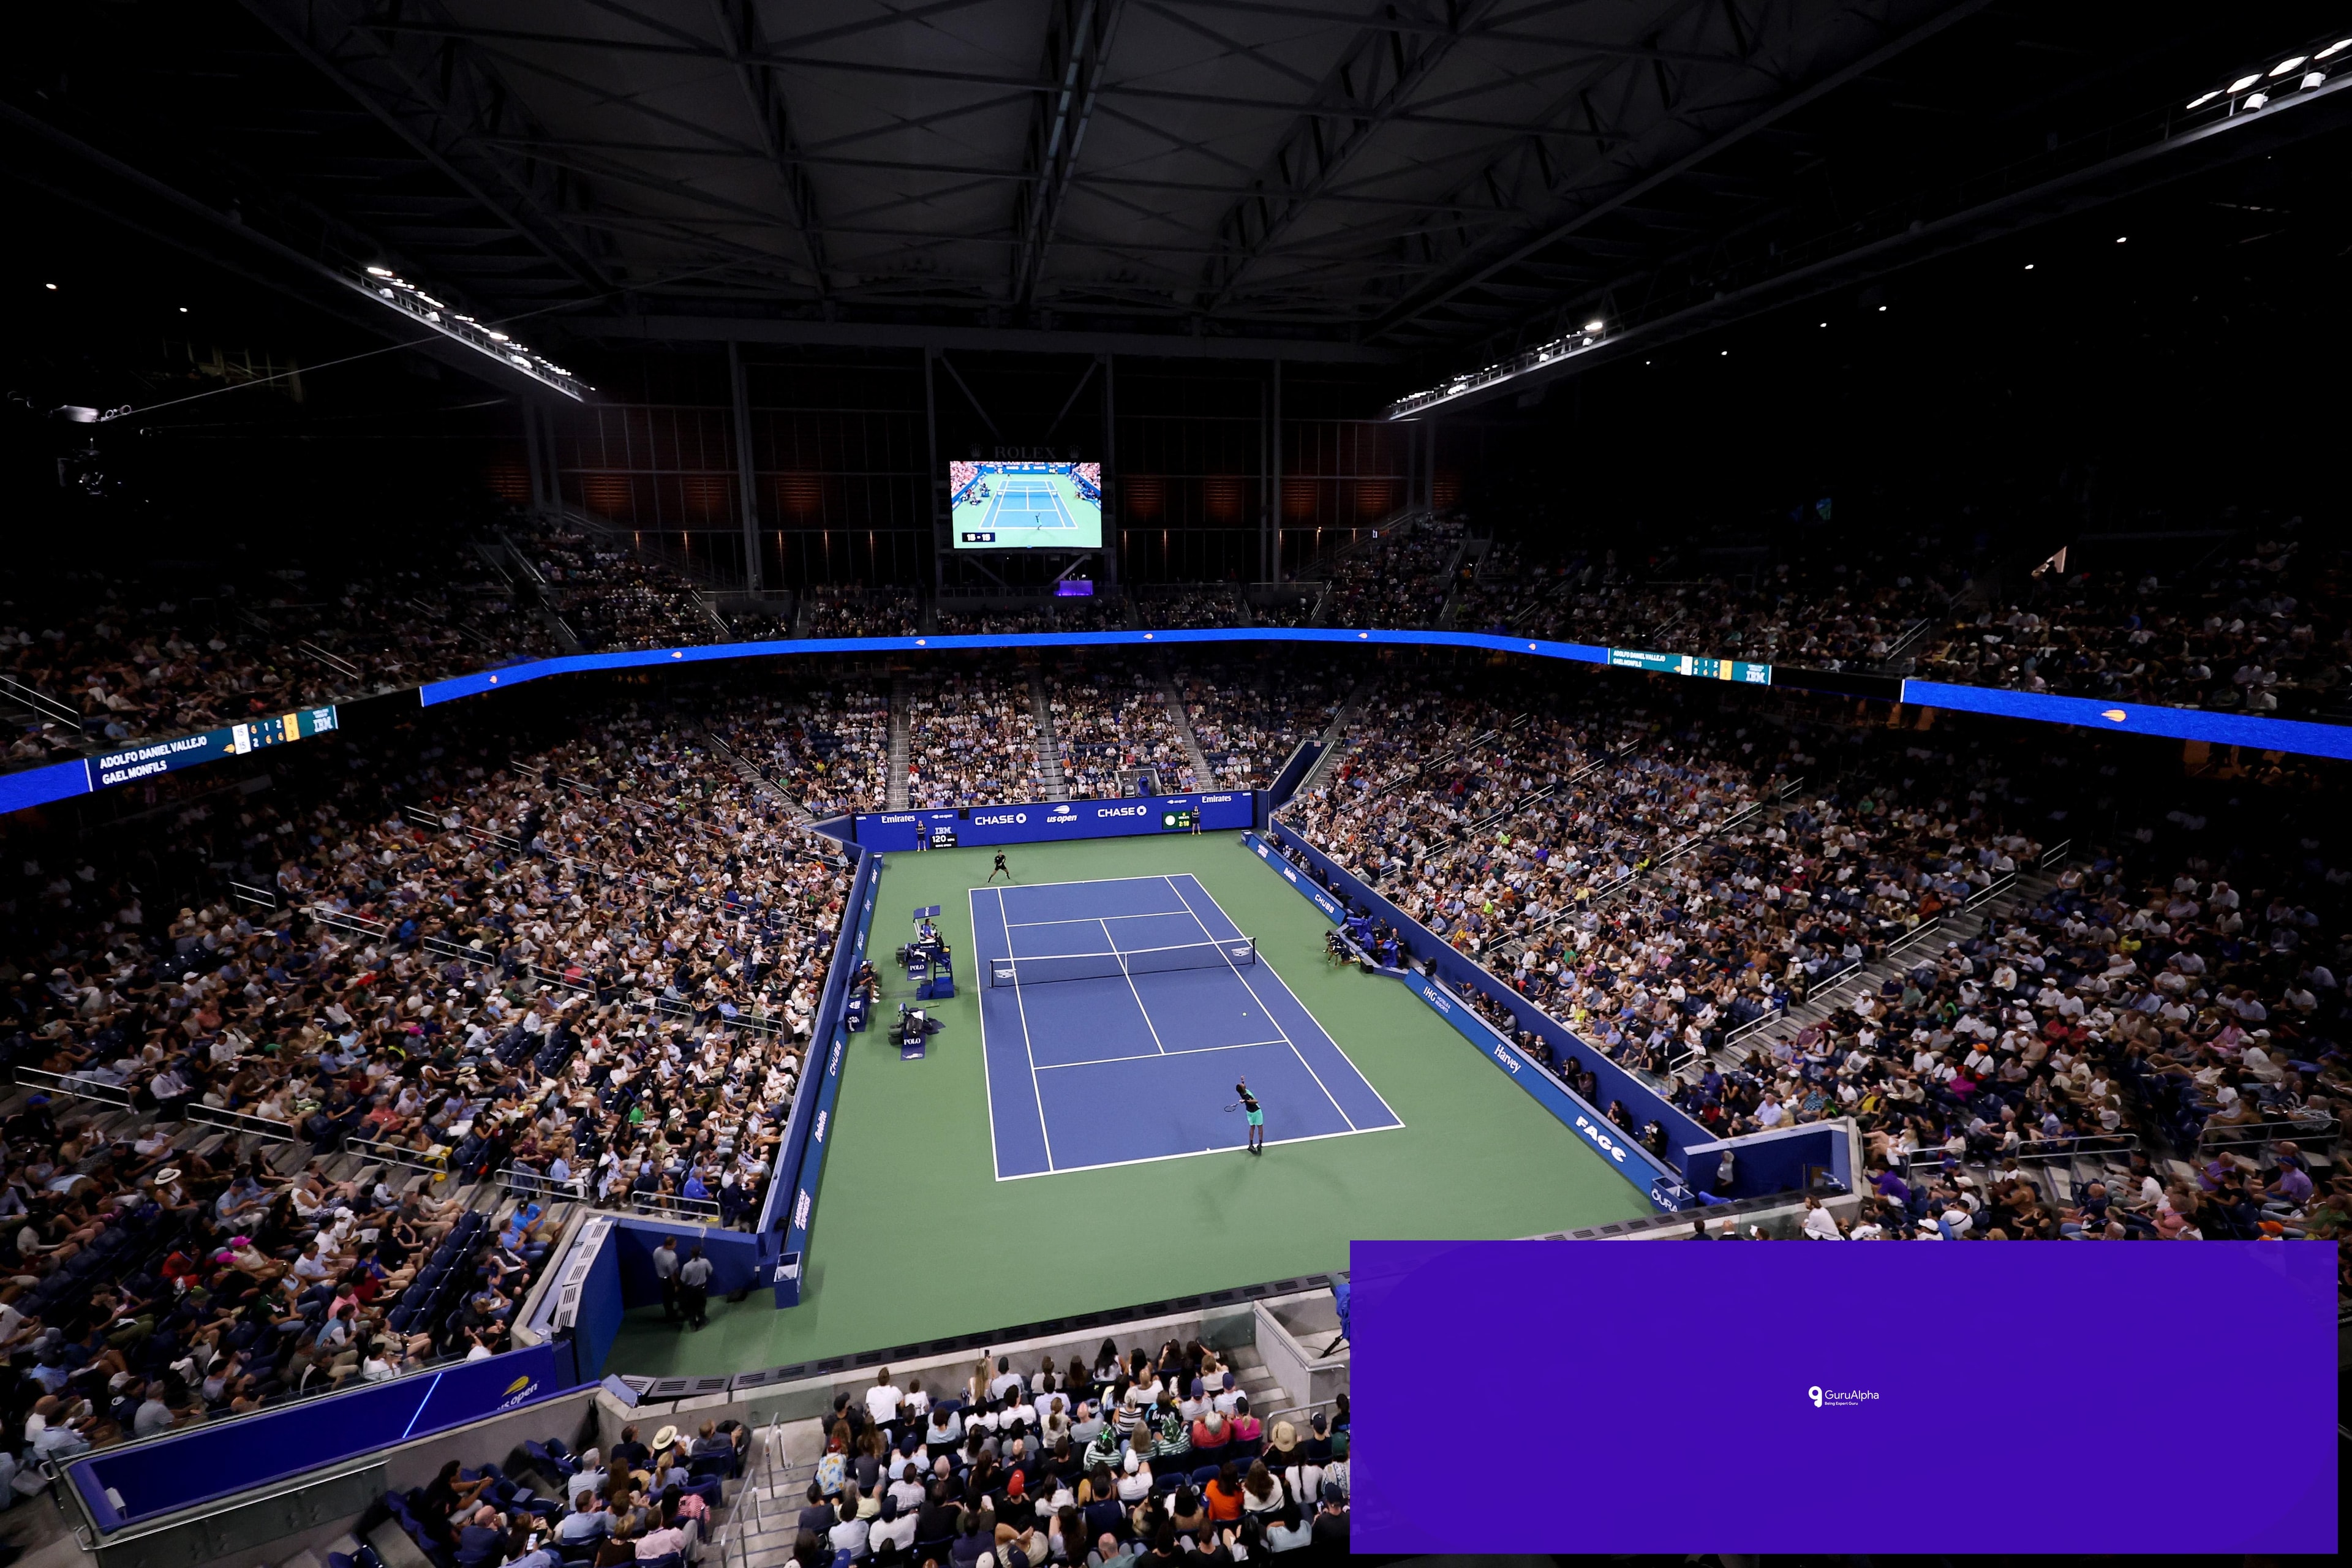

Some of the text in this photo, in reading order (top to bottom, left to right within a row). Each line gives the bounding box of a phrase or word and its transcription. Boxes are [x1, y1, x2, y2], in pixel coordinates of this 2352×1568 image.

[995, 446, 1056, 459] ROLEX
[1746, 670, 1765, 683] IBM
[251, 725, 257, 734] 6
[264, 722, 269, 731] 1
[276, 719, 282, 729] 2
[313, 716, 333, 733] IBM
[253, 738, 259, 747] 2
[266, 735, 272, 744] 6
[278, 732, 284, 741] 6
[100, 736, 207, 769] ADOLFO DANIEL VALLEJO
[102, 760, 167, 785] GAEL MONFILS
[1202, 795, 1232, 803] Emirates
[881, 815, 915, 824] Emirates
[975, 815, 1015, 825] CHASE
[1057, 814, 1077, 824] open
[1098, 807, 1135, 818] CHASE
[1314, 894, 1335, 914] CHUBB
[1423, 986, 1437, 1002] IHG
[830, 1040, 842, 1077] CHUBB
[1494, 1044, 1522, 1074] Harvey
[815, 1110, 827, 1143] Deloitte
[1576, 1116, 1627, 1163] FAGE
[510, 1383, 538, 1405] open
